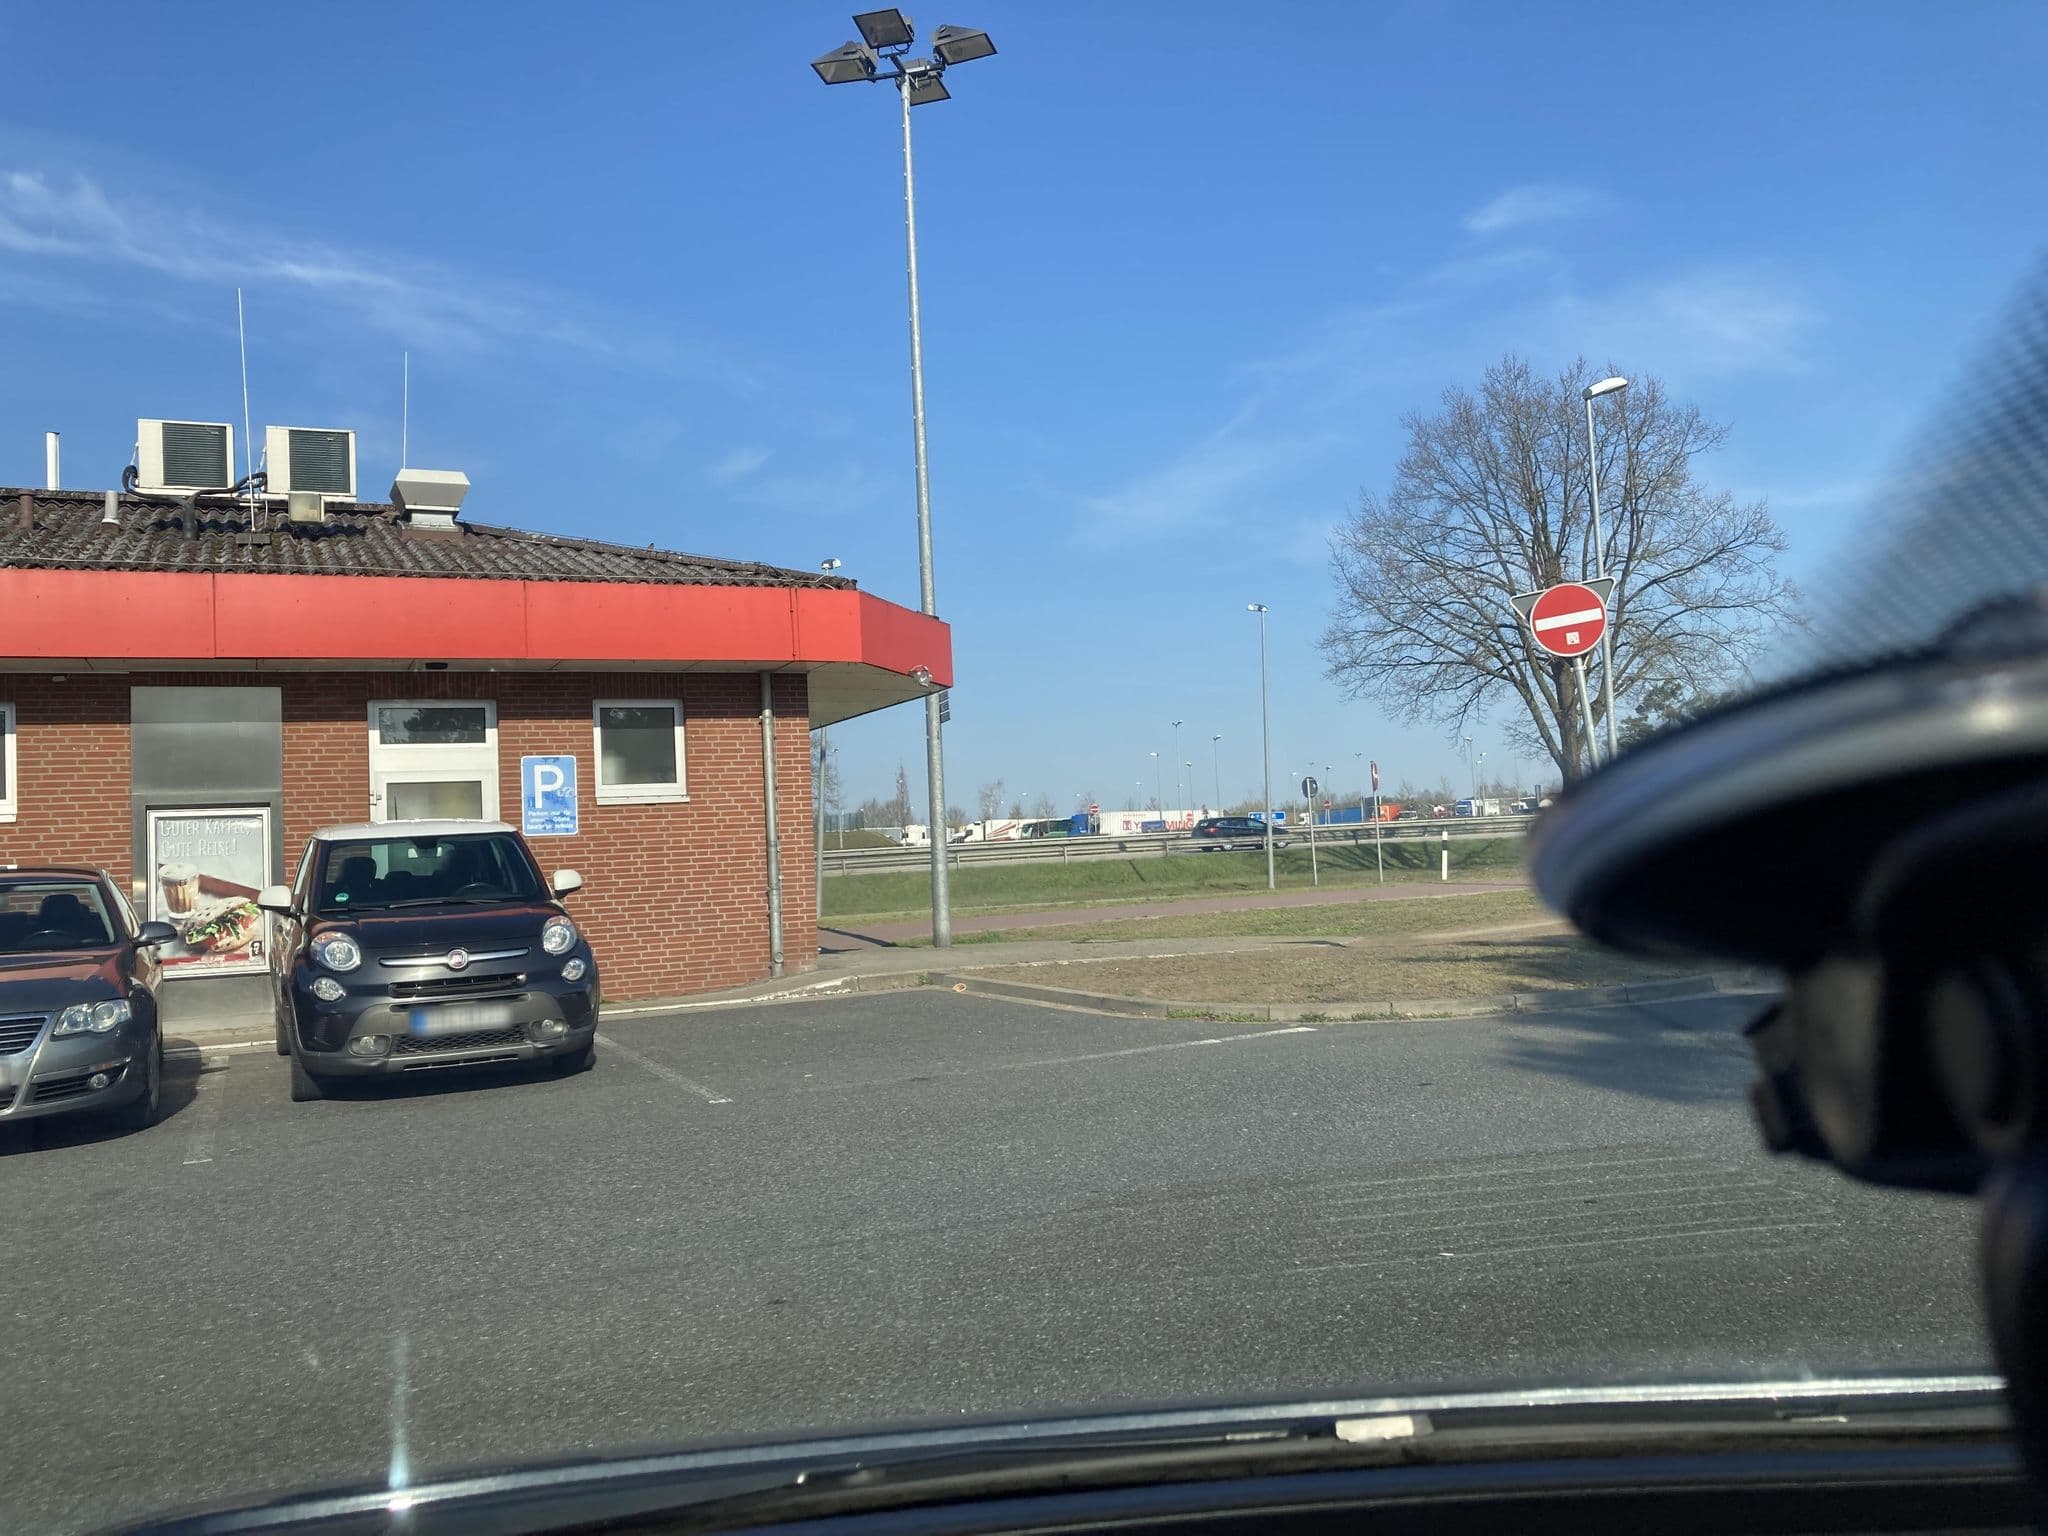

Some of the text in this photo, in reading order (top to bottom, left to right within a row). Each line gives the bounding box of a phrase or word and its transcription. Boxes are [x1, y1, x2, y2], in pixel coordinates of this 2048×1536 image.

[534, 764, 564, 808] P
[161, 820, 200, 836] GUTER
[162, 840, 192, 857] GUTE
